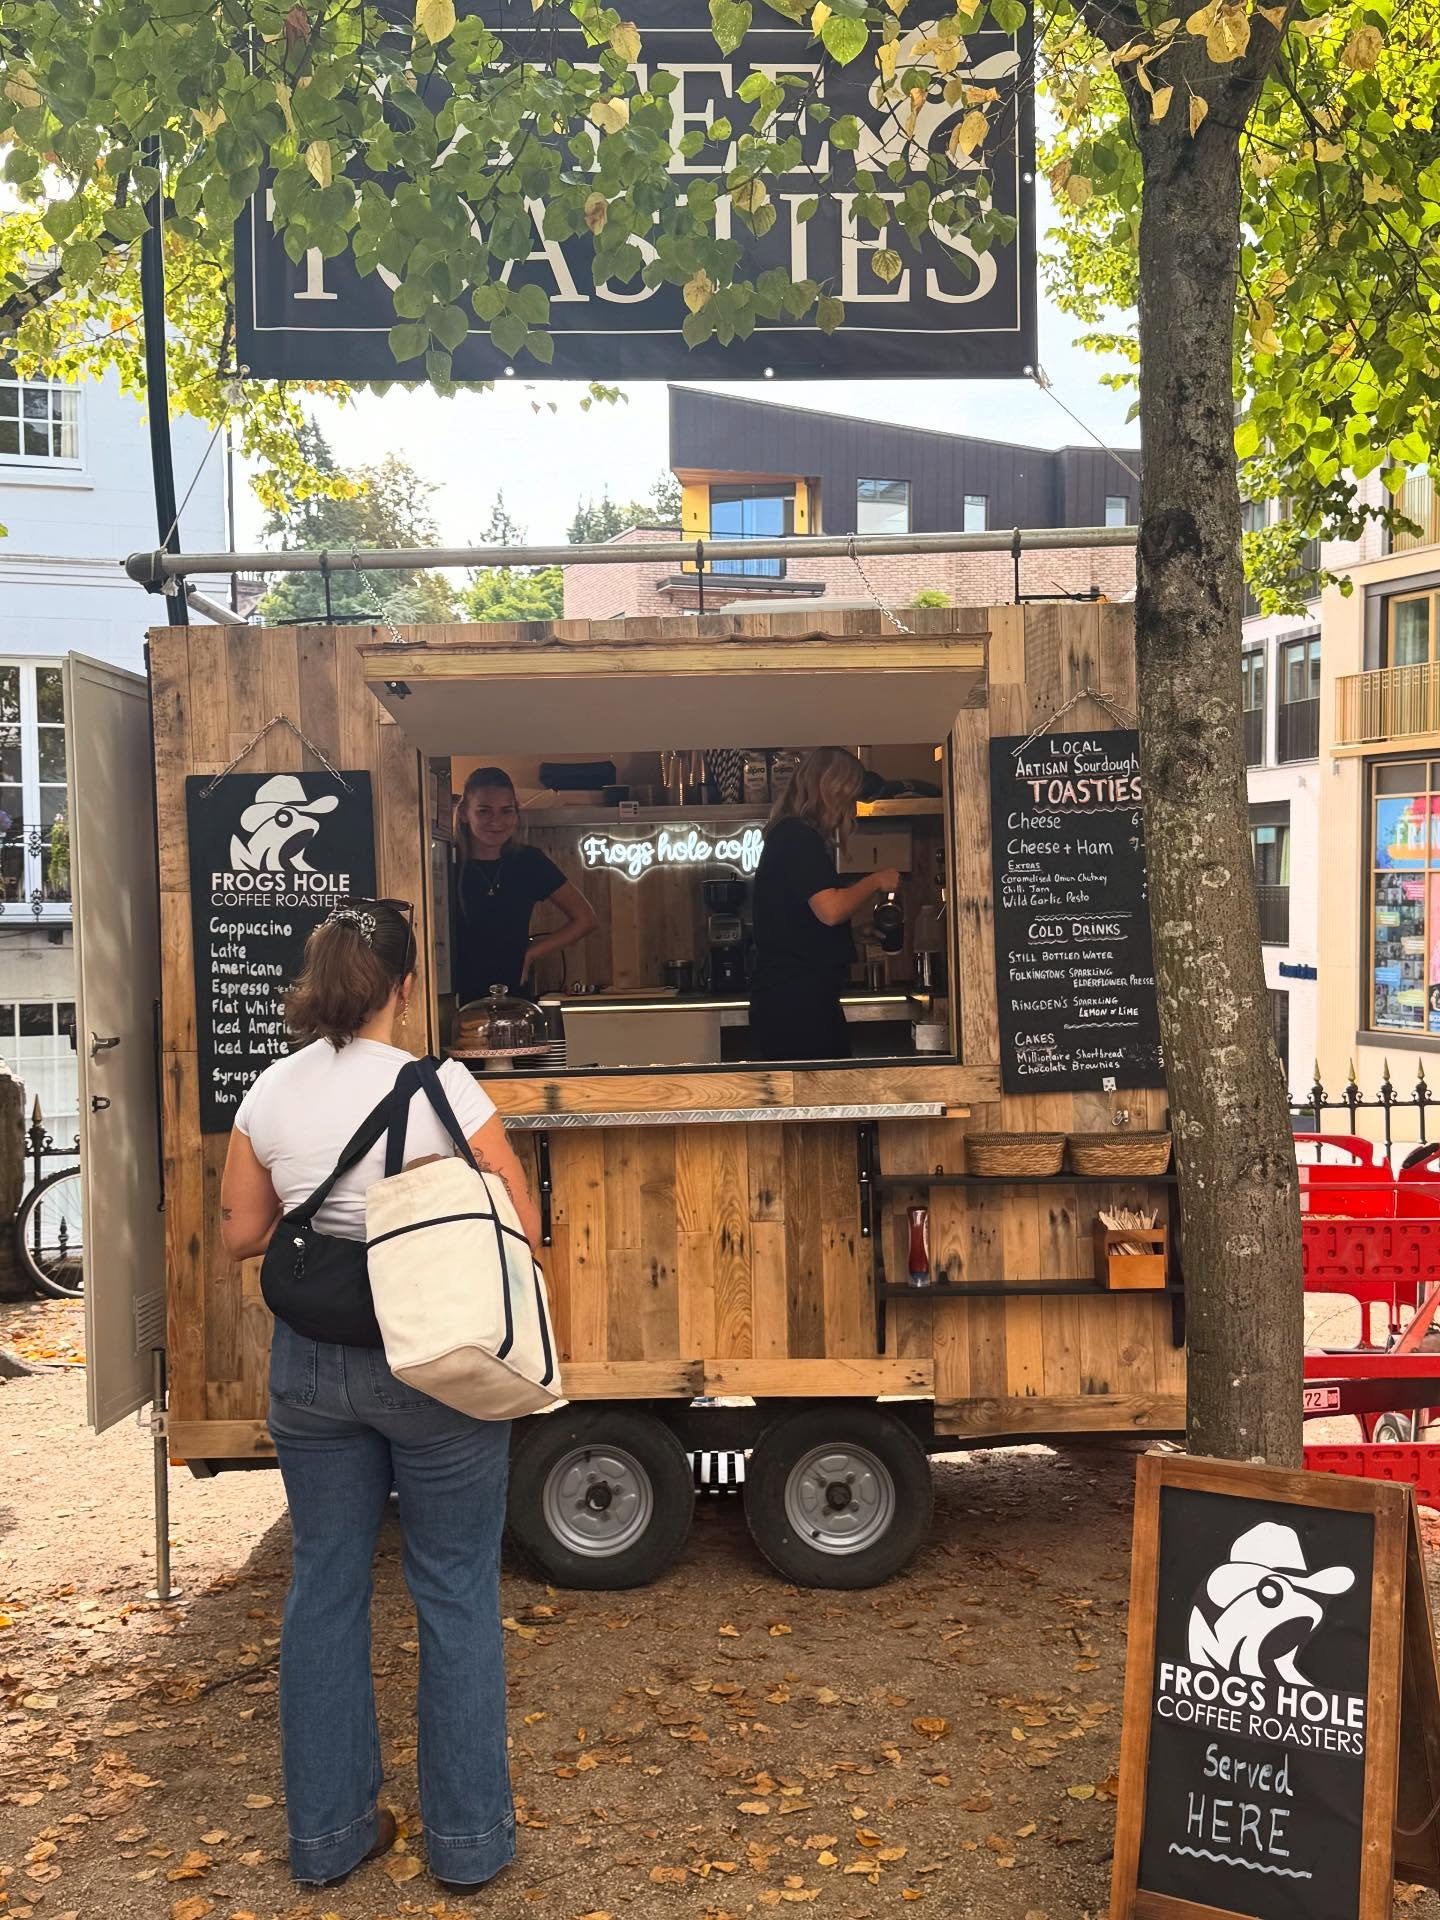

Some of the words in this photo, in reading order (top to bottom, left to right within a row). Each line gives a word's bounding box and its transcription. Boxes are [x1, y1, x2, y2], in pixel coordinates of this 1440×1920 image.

[1050, 739, 1103, 755] LOCAL
[1015, 756, 1069, 778] ARTISAN
[1073, 751, 1140, 778] Sourdough
[1027, 774, 1143, 805] TOASTIES
[1007, 812, 1062, 830] Cheese
[583, 836, 656, 876] Frogs
[657, 830, 713, 862] hole
[1007, 838, 1060, 855] Cheese
[1076, 839, 1115, 855] Ham
[211, 872, 287, 892] FROGS
[293, 873, 350, 892] HOLE
[211, 893, 271, 907] COFFEE
[1003, 894, 1028, 909] Wild
[1030, 892, 1063, 906] Garlic
[1066, 889, 1090, 903] Pesto
[209, 916, 293, 941] Cappuccino
[1028, 923, 1063, 939] COLD
[1072, 923, 1121, 937] DRINKS
[210, 942, 247, 959] Latte
[211, 960, 283, 977] Americano
[211, 978, 270, 999] Espresso
[212, 998, 239, 1014] Flat
[245, 998, 286, 1016] White
[212, 1018, 241, 1035] Iced
[213, 1039, 243, 1055] Iced
[249, 1038, 290, 1055] Latte
[1014, 1031, 1056, 1046] CAKES
[1016, 1050, 1070, 1063] Millionaire
[1075, 1047, 1124, 1060] Shortbread
[212, 1067, 258, 1086] Syrups
[1018, 1061, 1068, 1075] Chocolate
[1072, 1060, 1121, 1072] Brownies
[215, 1089, 238, 1103] Non
[1159, 1662, 1266, 1712] FROGS
[1277, 1685, 1364, 1729] HOLE
[1157, 1695, 1243, 1733] COFFEE
[1249, 1714, 1364, 1755] ROASTERS
[1203, 1742, 1294, 1797] Served
[1186, 1791, 1291, 1857] HERE
